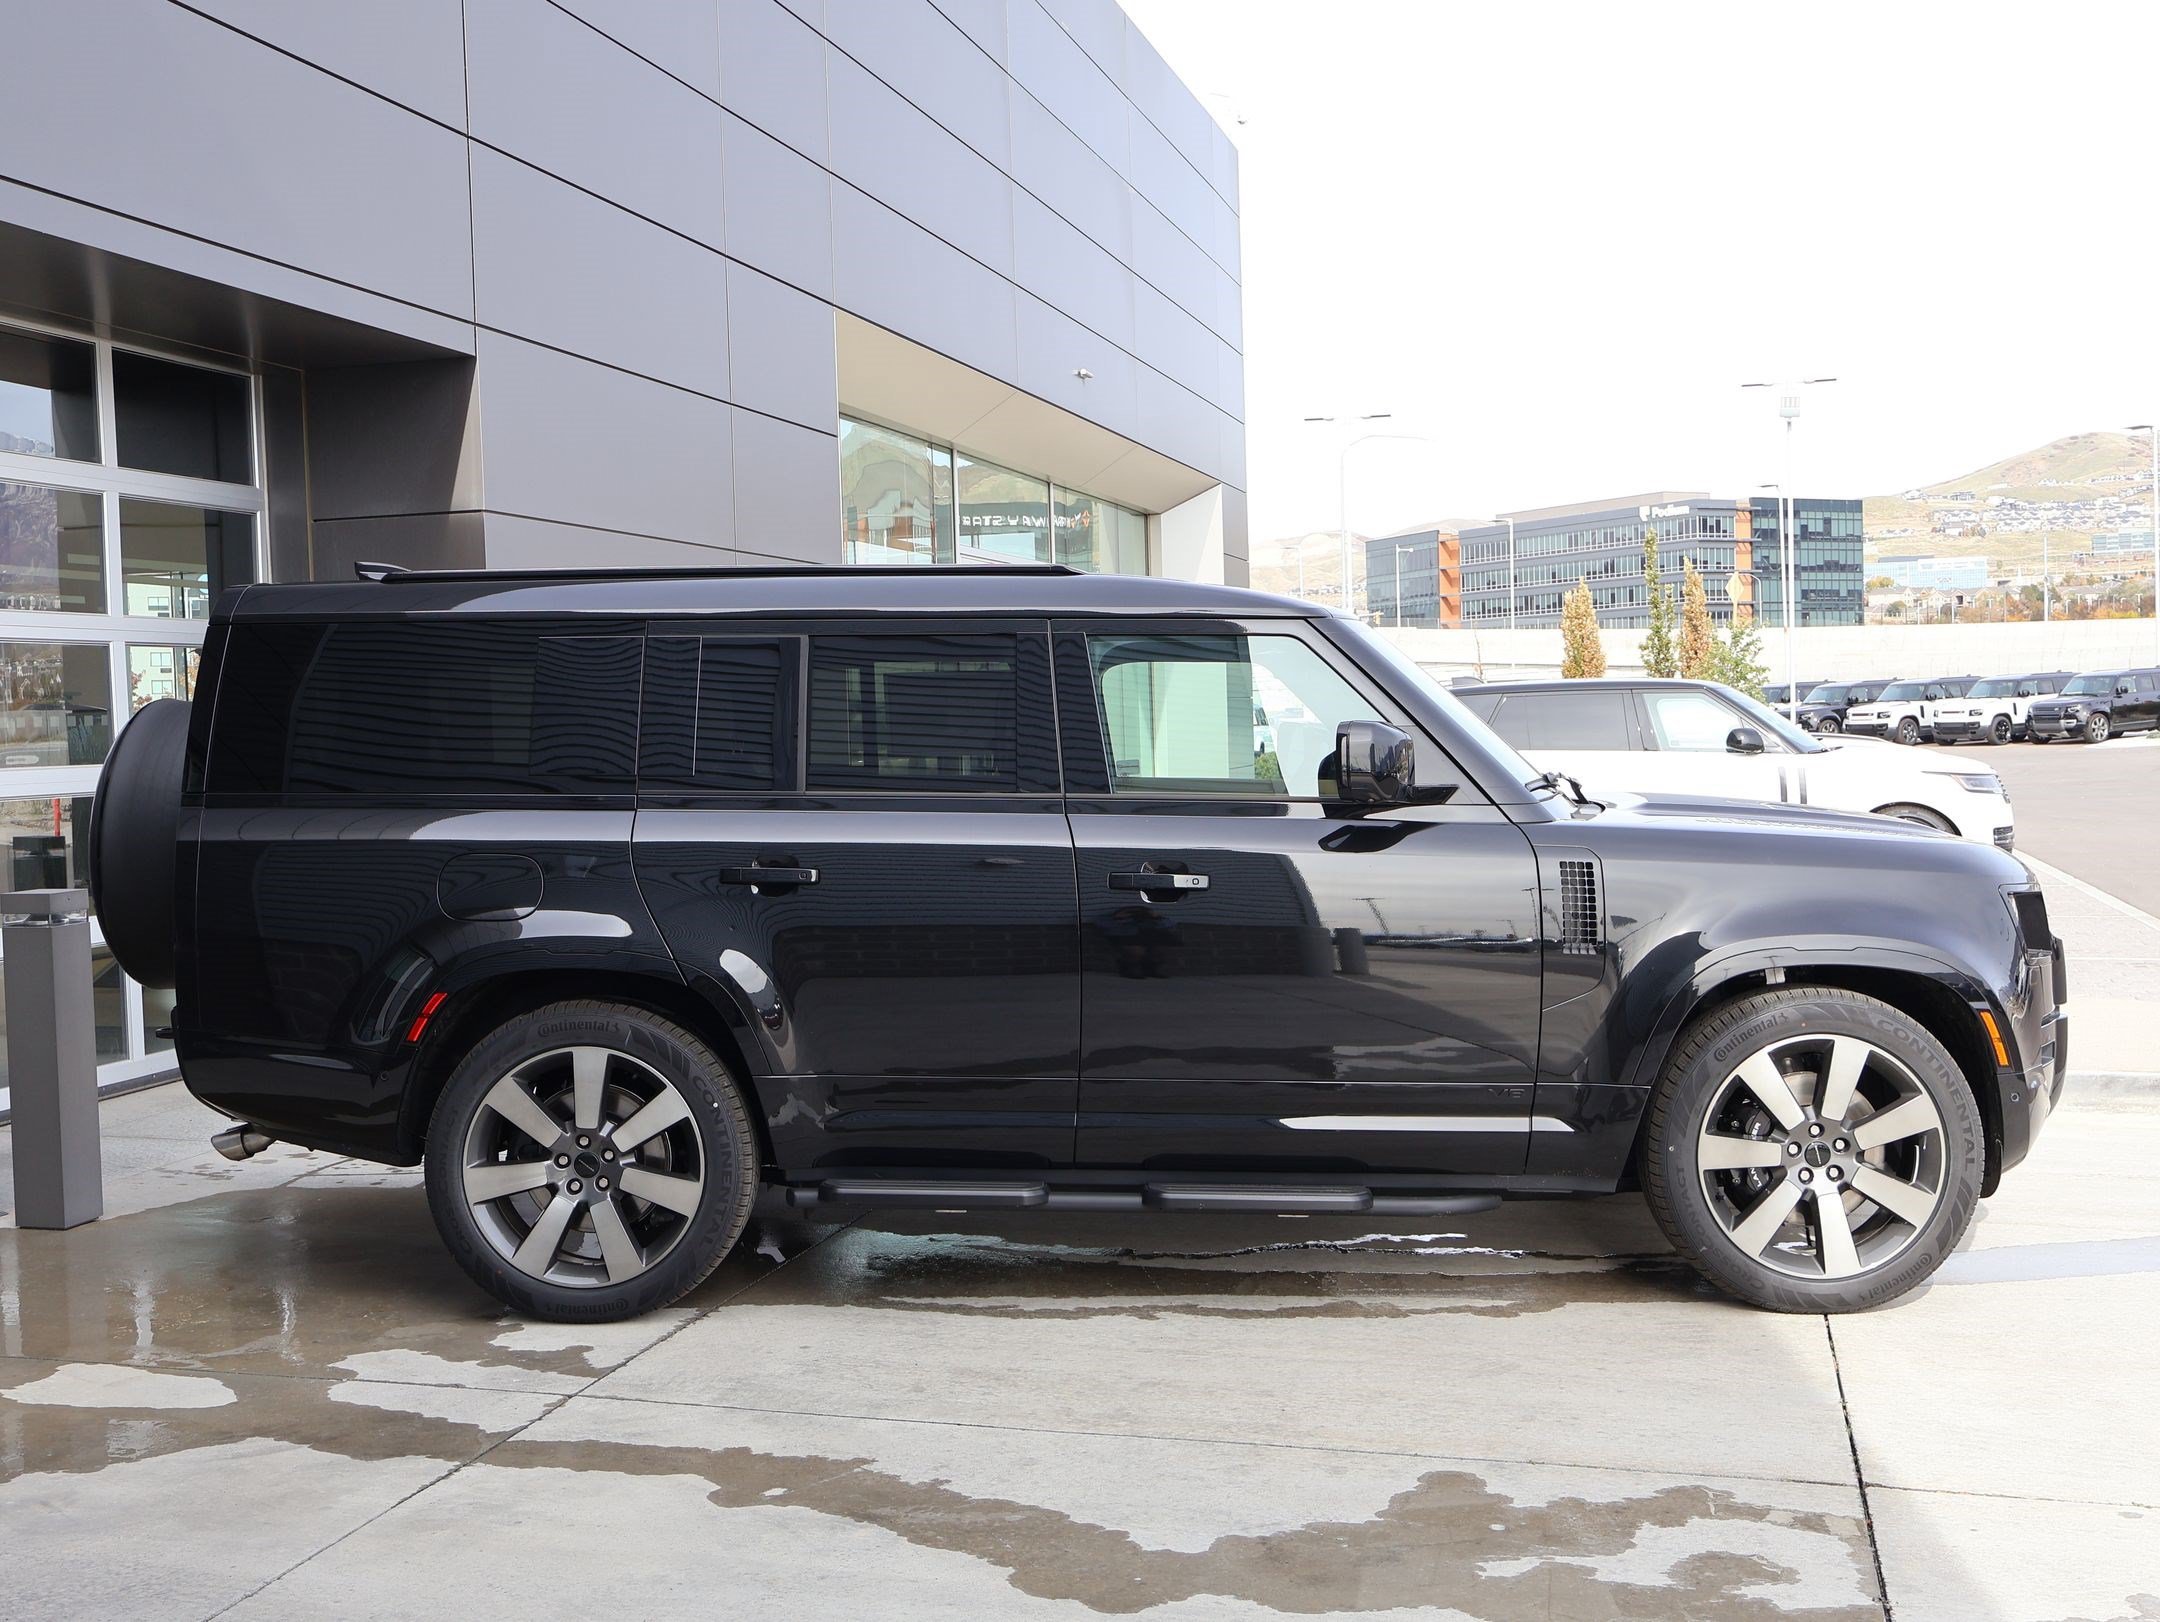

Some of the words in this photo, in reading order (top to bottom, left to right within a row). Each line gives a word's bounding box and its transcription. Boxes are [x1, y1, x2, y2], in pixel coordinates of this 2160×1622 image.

[537, 1020, 610, 1037] Continental
[1714, 1013, 1779, 1061] Continental
[1876, 1020, 1976, 1171] CONTINENTAL
